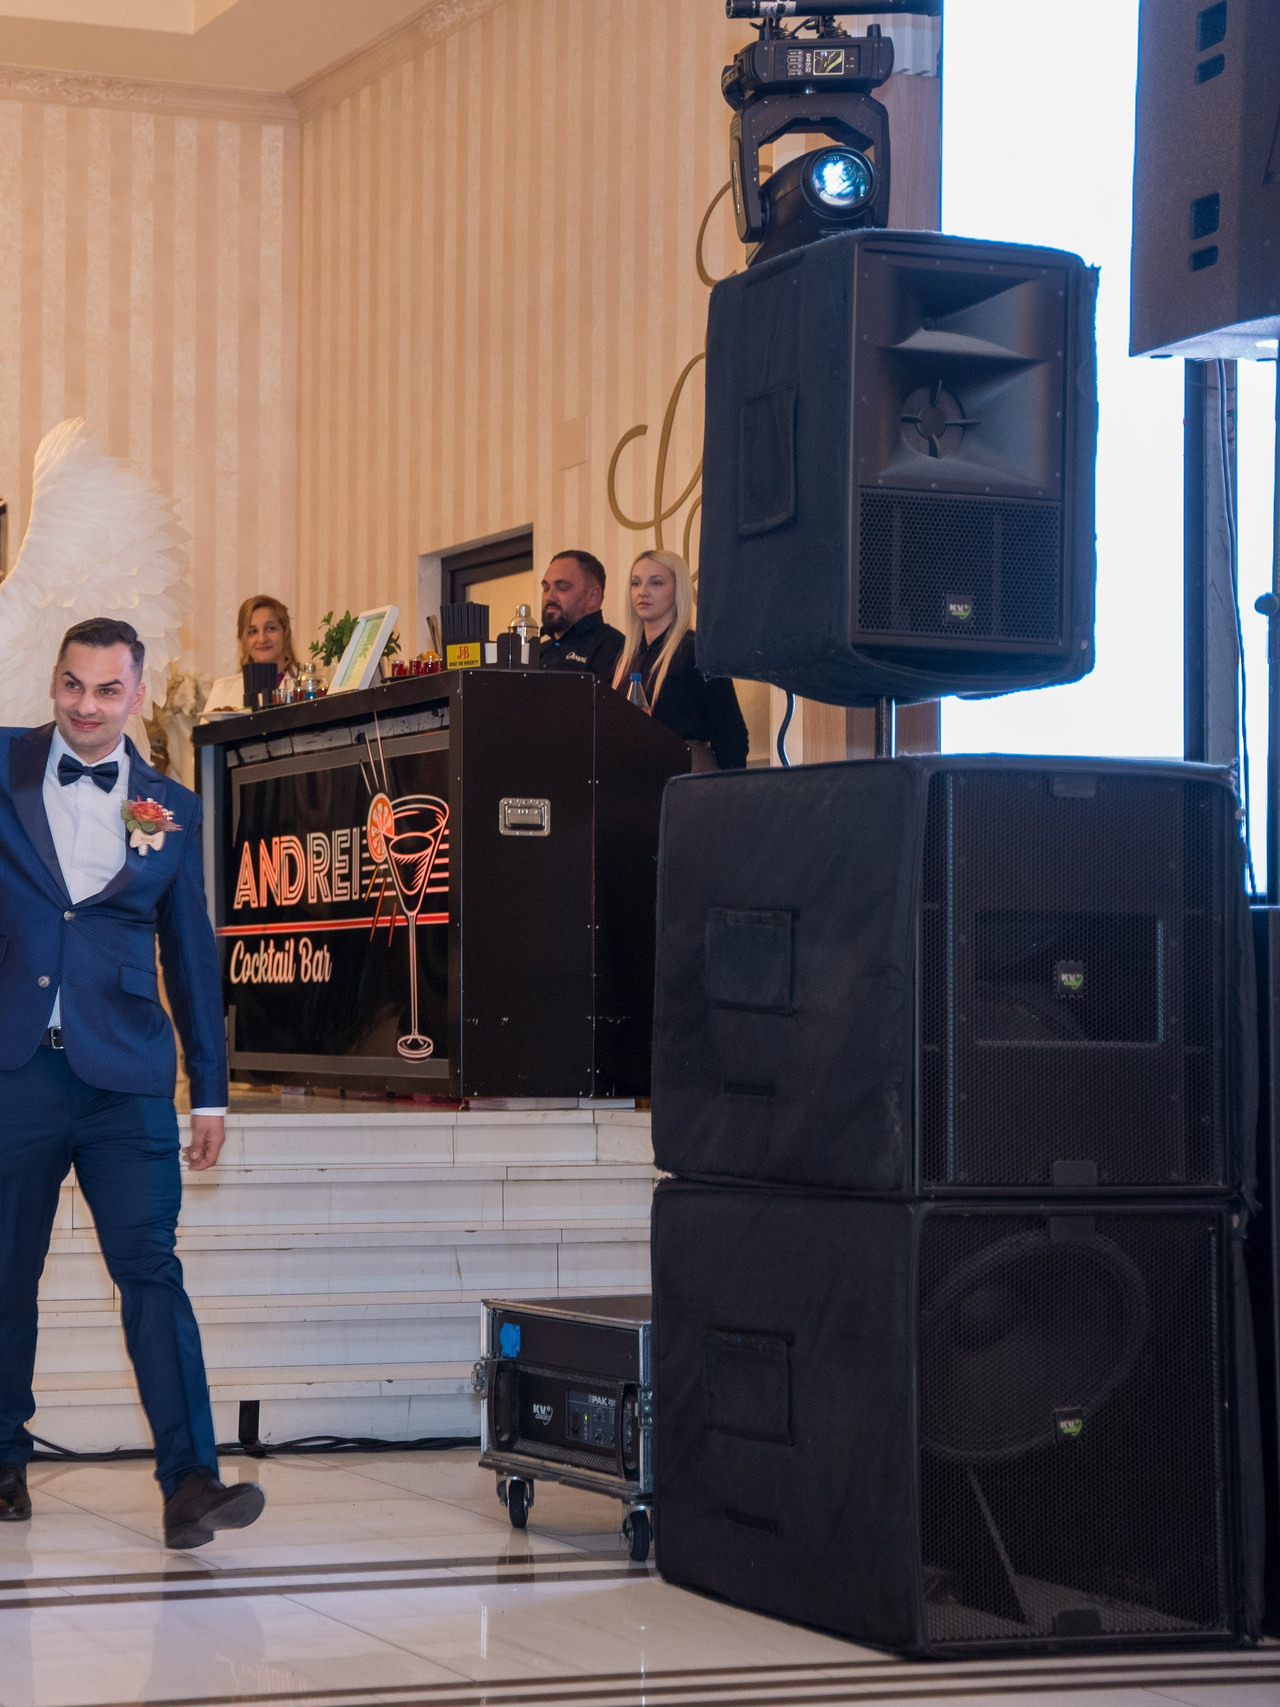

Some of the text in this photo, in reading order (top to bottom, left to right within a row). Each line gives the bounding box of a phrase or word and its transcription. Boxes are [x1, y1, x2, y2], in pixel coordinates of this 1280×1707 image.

[233, 826, 360, 910] ANDREI
[229, 936, 333, 984] Cocktail Bar
